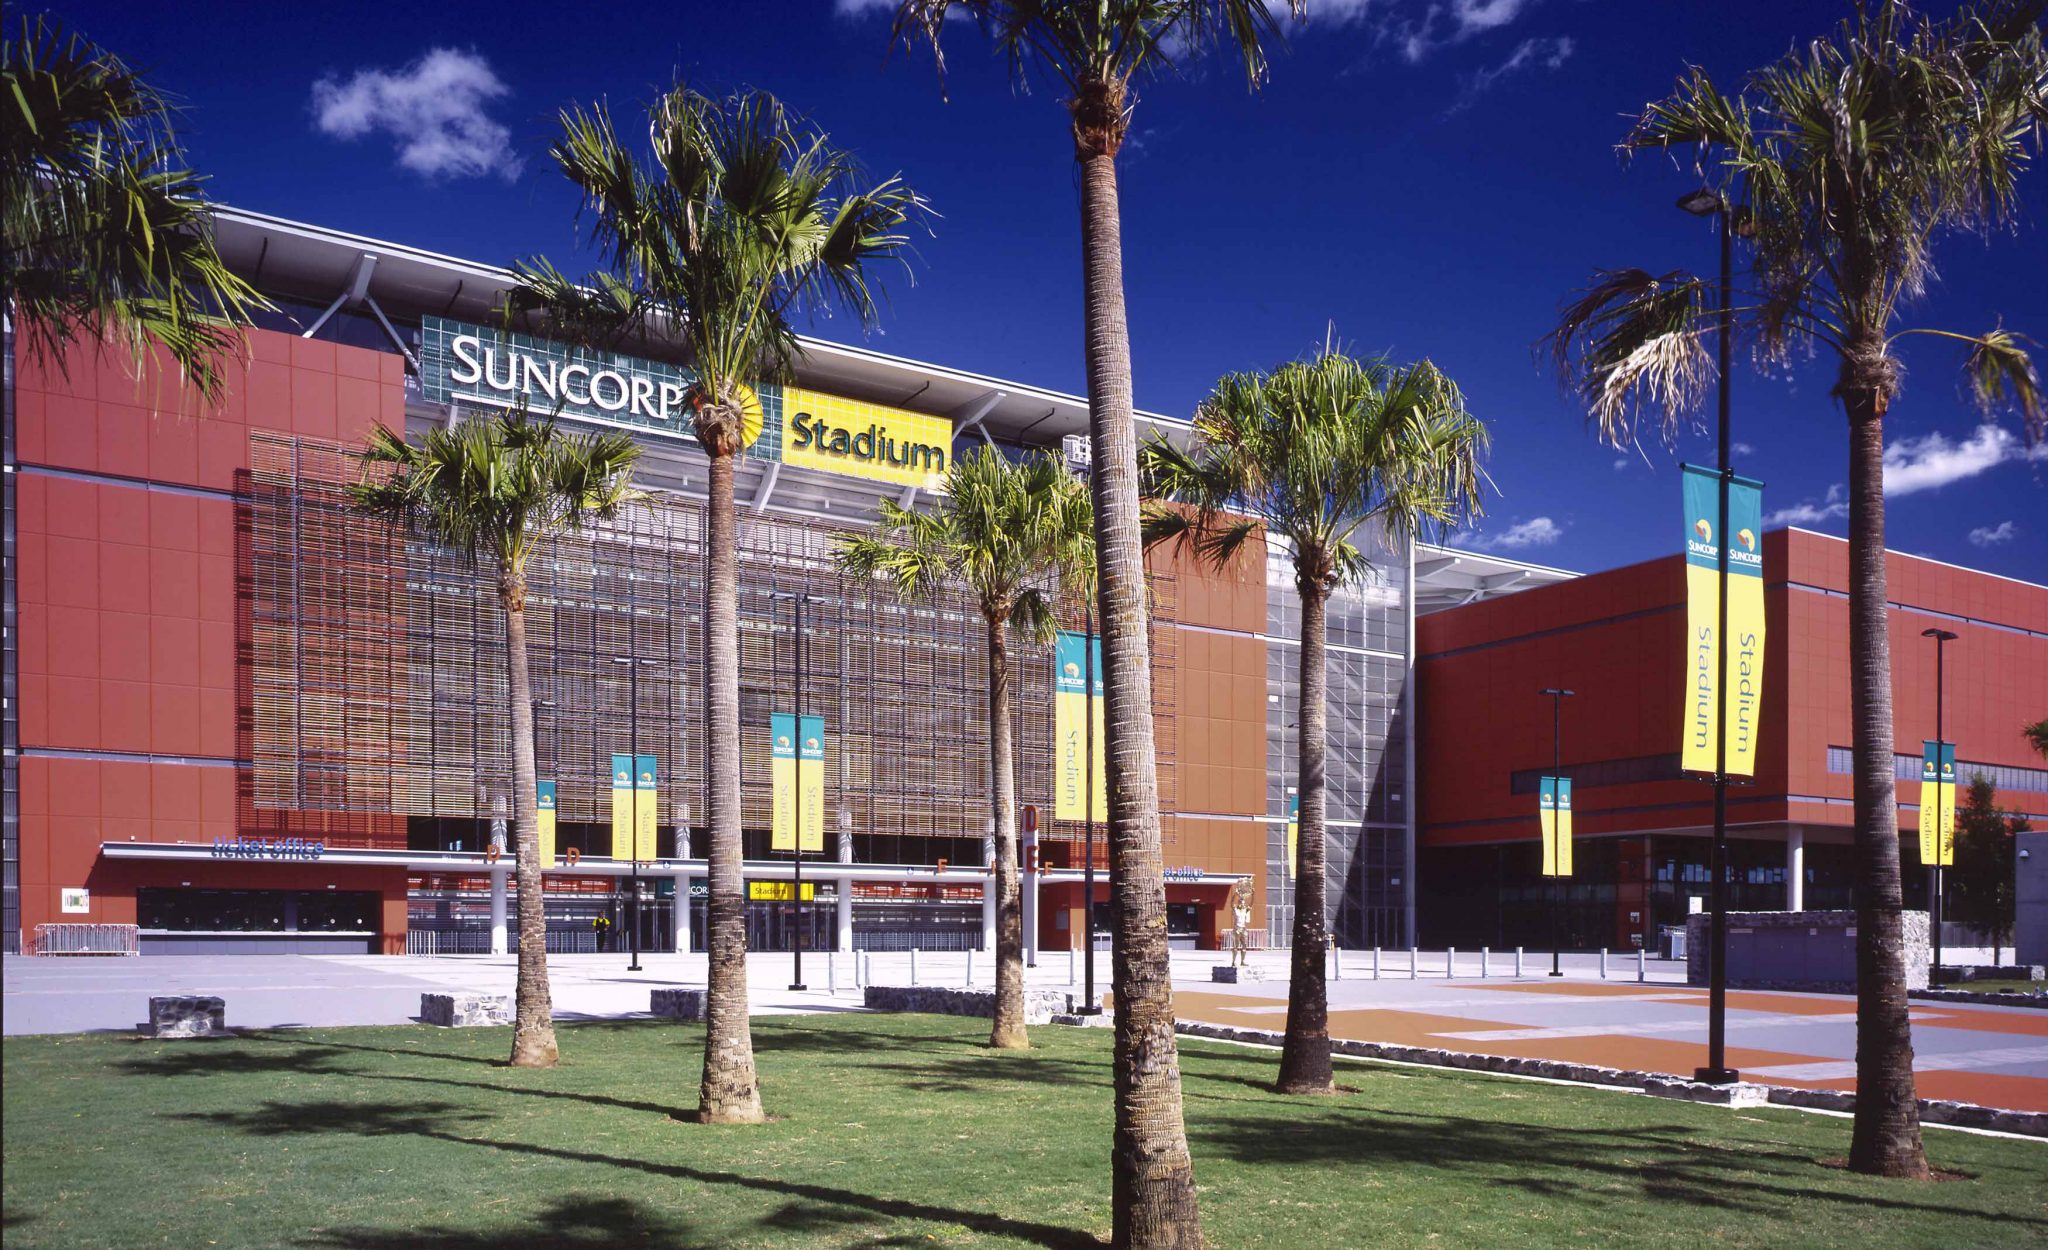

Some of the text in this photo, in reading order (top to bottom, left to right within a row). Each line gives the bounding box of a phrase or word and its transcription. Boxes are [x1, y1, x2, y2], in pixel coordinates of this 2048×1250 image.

[451, 334, 684, 420] SUNCORP
[791, 411, 945, 471] Stadium
[1688, 539, 1718, 555] SUNCORP
[1729, 548, 1762, 564] SUNCORP
[1695, 626, 1712, 749] Stadium
[1737, 632, 1756, 753] Stadium
[1065, 730, 1079, 807] Stadium
[213, 836, 324, 853] ticket office
[487, 844, 500, 861] D
[566, 847, 580, 864] D
